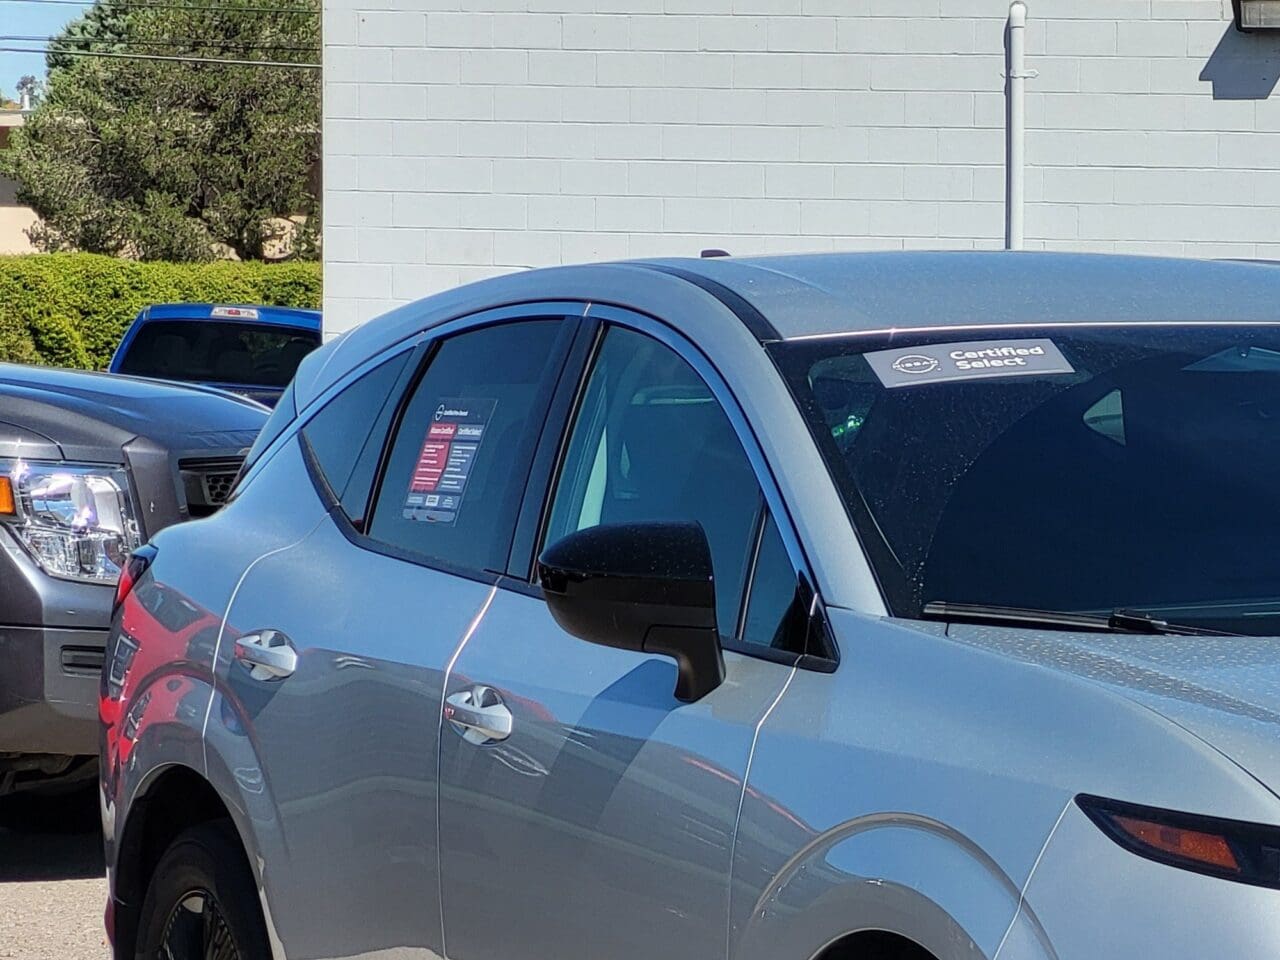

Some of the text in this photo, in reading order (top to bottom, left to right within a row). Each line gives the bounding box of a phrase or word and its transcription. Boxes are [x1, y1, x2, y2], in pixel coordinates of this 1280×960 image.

[950, 346, 1044, 360] Certified
[892, 359, 939, 369] NISSAN
[956, 357, 1027, 370] Select
